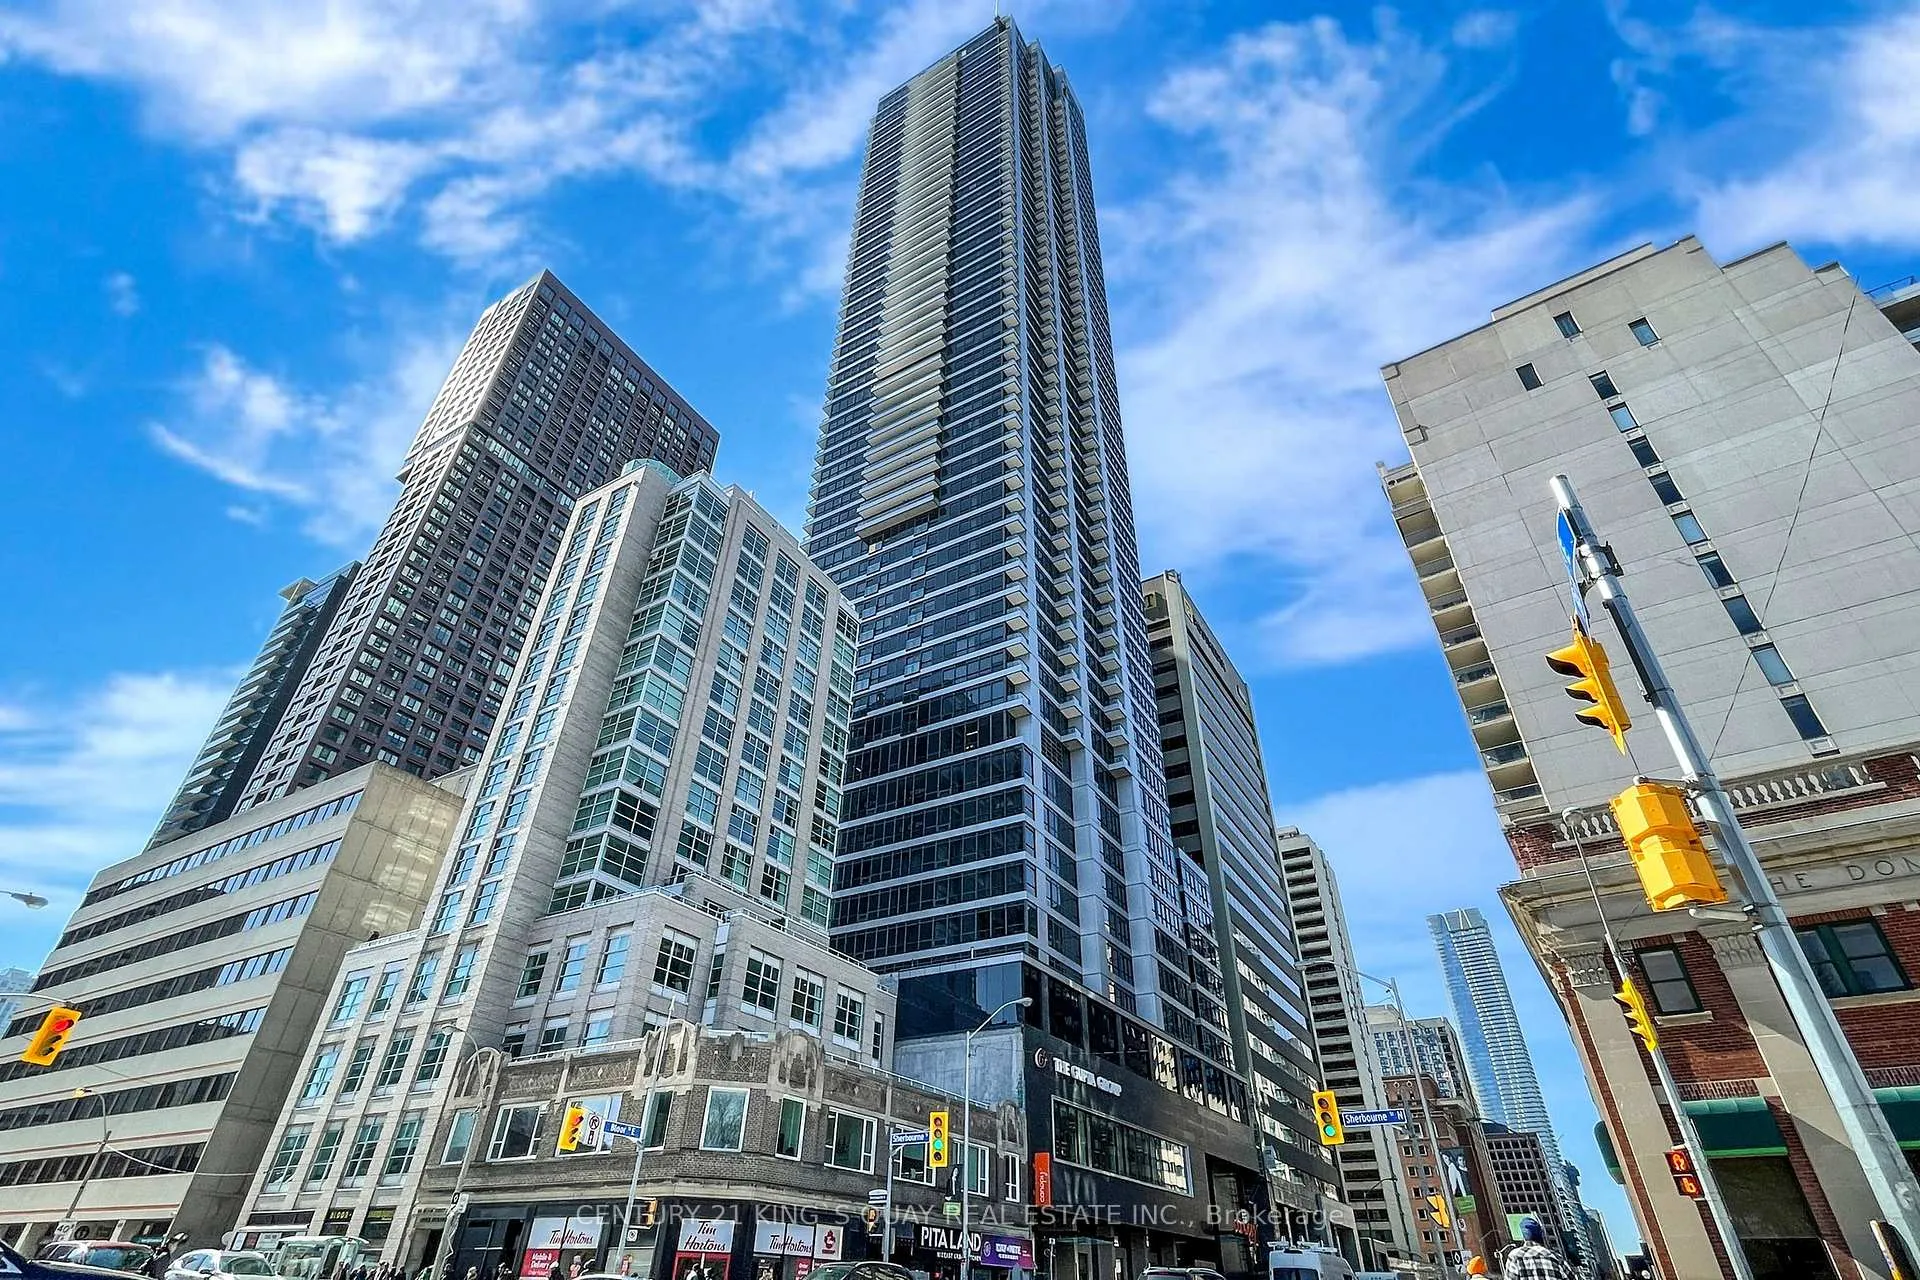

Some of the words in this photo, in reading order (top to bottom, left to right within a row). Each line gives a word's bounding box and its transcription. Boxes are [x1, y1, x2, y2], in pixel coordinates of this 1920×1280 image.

[1768, 872, 1813, 892] HE
[1345, 1112, 1388, 1124] Sherbourne
[1396, 1110, 1403, 1120] N
[610, 1123, 626, 1135] Bloor
[631, 1127, 636, 1136] E
[892, 1133, 925, 1143] Sherbourne
[697, 1221, 717, 1236] Tim
[550, 1229, 562, 1245] Tim
[561, 1229, 594, 1245] Hortons
[683, 1234, 727, 1252] Hortons
[770, 1234, 784, 1250] Tim
[783, 1236, 812, 1254] Hortons
[921, 1226, 948, 1249] PITA
